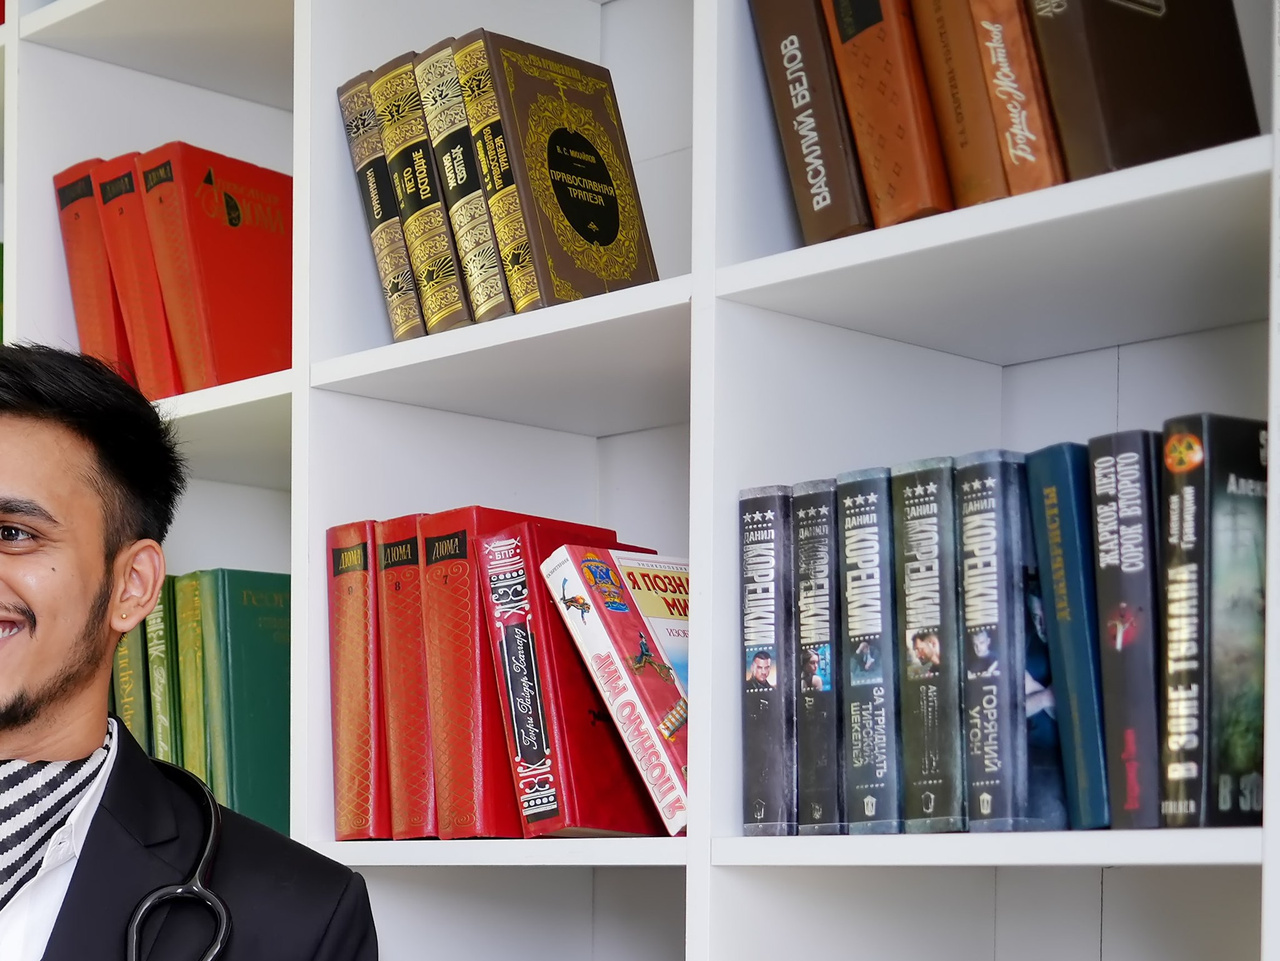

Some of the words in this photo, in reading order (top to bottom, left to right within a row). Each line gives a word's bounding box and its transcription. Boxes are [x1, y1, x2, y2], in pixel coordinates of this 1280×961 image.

[779, 34, 811, 109] БЕЛОВ
[980, 20, 1027, 101] Житков
[494, 135, 510, 173] ТРАПЕЗА
[1003, 100, 1036, 166] Борис
[412, 149, 432, 201] ГОСПОДНЕ
[442, 152, 457, 190] ЖИТИЯ
[451, 144, 468, 185] СВЯТЫХ
[481, 127, 504, 190] ПРАВОСЛАВНАЯ
[793, 109, 831, 212] ВАСИЛИЙ
[403, 166, 417, 195] ЛЕТО
[549, 169, 616, 197] ПРАВОСЛАВНАЯ
[567, 186, 605, 207] ТРАПЕЗА
[1094, 455, 1116, 498] ЛЕТО
[1115, 452, 1140, 512] ВТОРОГО
[844, 513, 877, 529] ДАНИЛ
[904, 503, 938, 518] ДАНИЛ
[962, 498, 996, 514] ДАНИЛ
[383, 542, 412, 566] ДЮМА
[433, 536, 460, 559] ДЮМА
[495, 549, 515, 560] БПР
[743, 529, 775, 544] ДАНИЛ
[1042, 485, 1072, 621] ДЕКАБРИСТЫ
[1098, 500, 1119, 569] ЖАРКОЕ
[1119, 512, 1145, 573] СОРОК
[338, 547, 362, 571] ДЮМА
[442, 574, 449, 585] 7
[962, 511, 999, 628] КОРЕЦКИЙ
[347, 585, 354, 596] 9
[394, 581, 402, 592] 8
[626, 571, 642, 591] Я
[844, 526, 883, 637] КОРЕЦКИЙ
[1167, 563, 1199, 675] ТУМАНА
[512, 627, 532, 673] Хаггард
[518, 672, 537, 716] Райдер
[590, 651, 629, 705] МИР
[873, 687, 885, 705] ЗА
[521, 716, 539, 751] Генри
[850, 702, 864, 767] ШЕКЕЛЕЙ
[861, 702, 874, 765] ТИРСКИХ
[969, 706, 982, 756] УГОН
[982, 685, 1002, 773] ГОРЯЧИЙ
[1166, 683, 1199, 753] ЗОНЕ
[616, 699, 677, 802] ПОЗНАЮ
[874, 707, 888, 778] ТРИДЦАТЬ
[1167, 758, 1199, 780] В
[659, 796, 687, 821] Я
